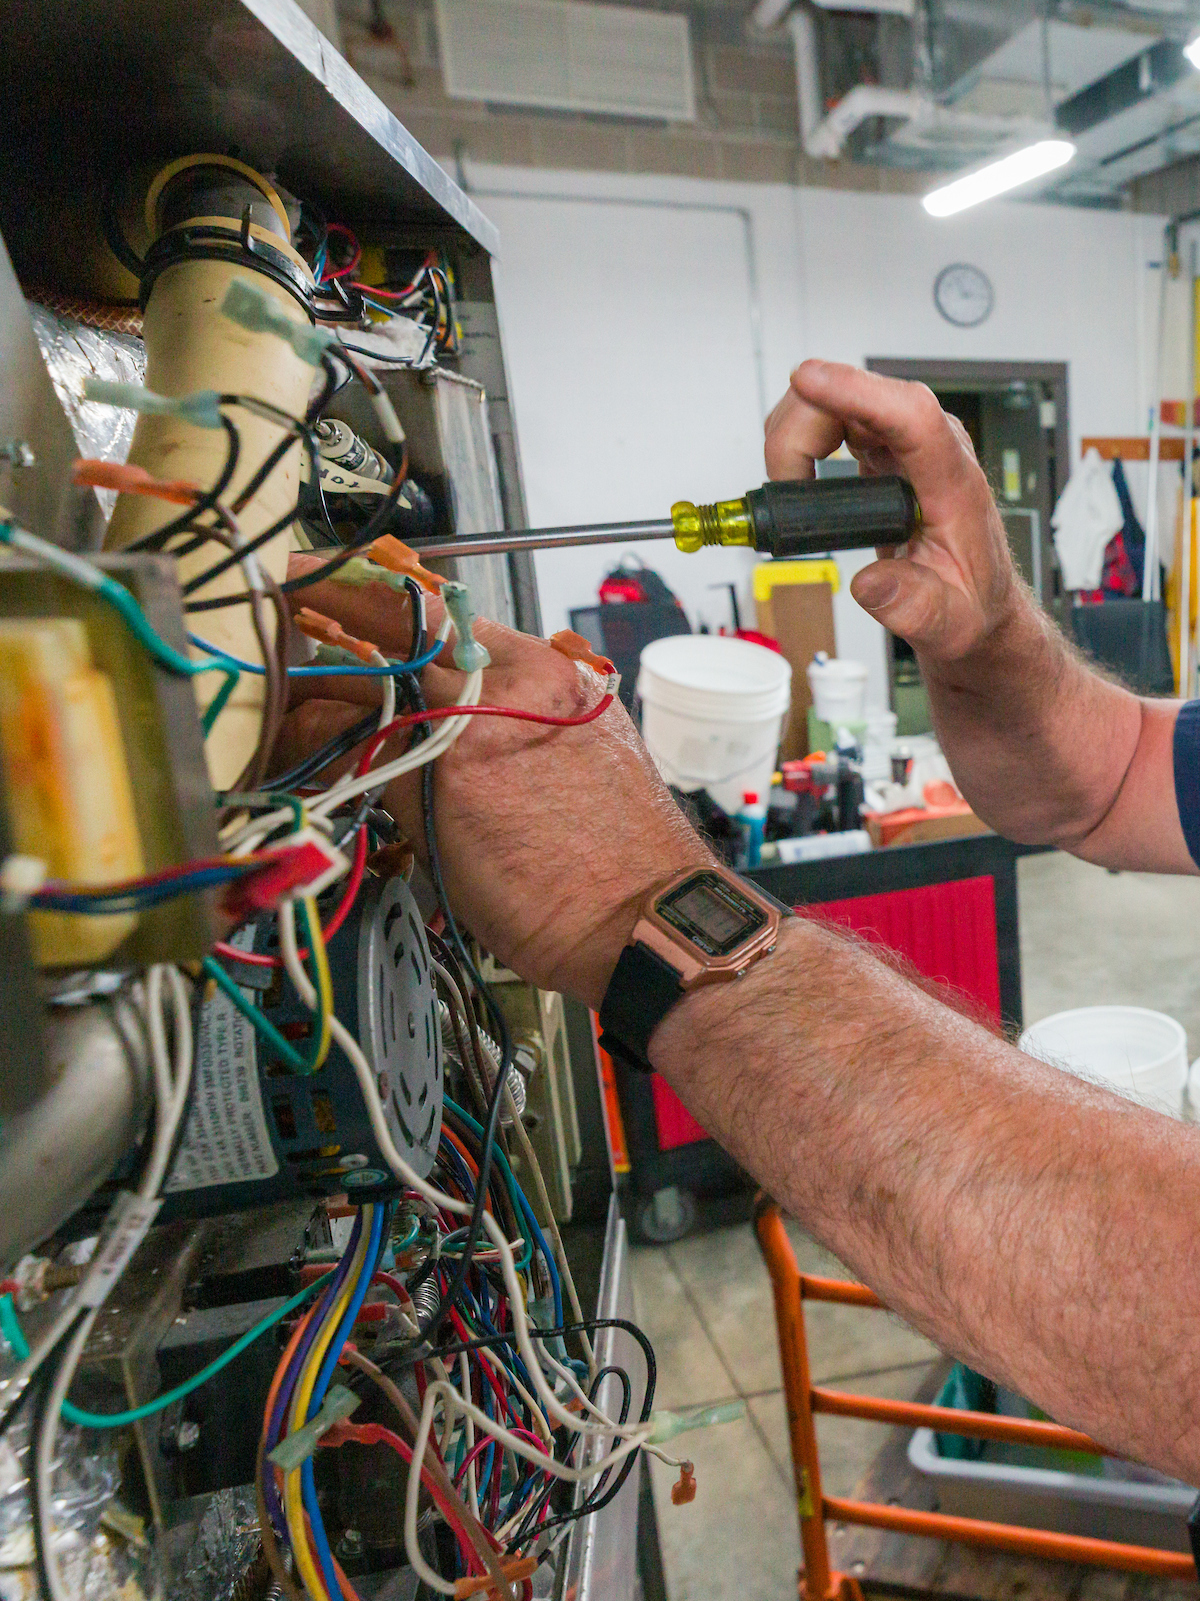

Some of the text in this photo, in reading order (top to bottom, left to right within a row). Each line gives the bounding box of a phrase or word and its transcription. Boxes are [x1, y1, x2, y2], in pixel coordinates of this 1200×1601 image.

[692, 935, 713, 954] CASIO
[216, 1028, 227, 1055] TYPE
[218, 1059, 236, 1125] PROTECTED
